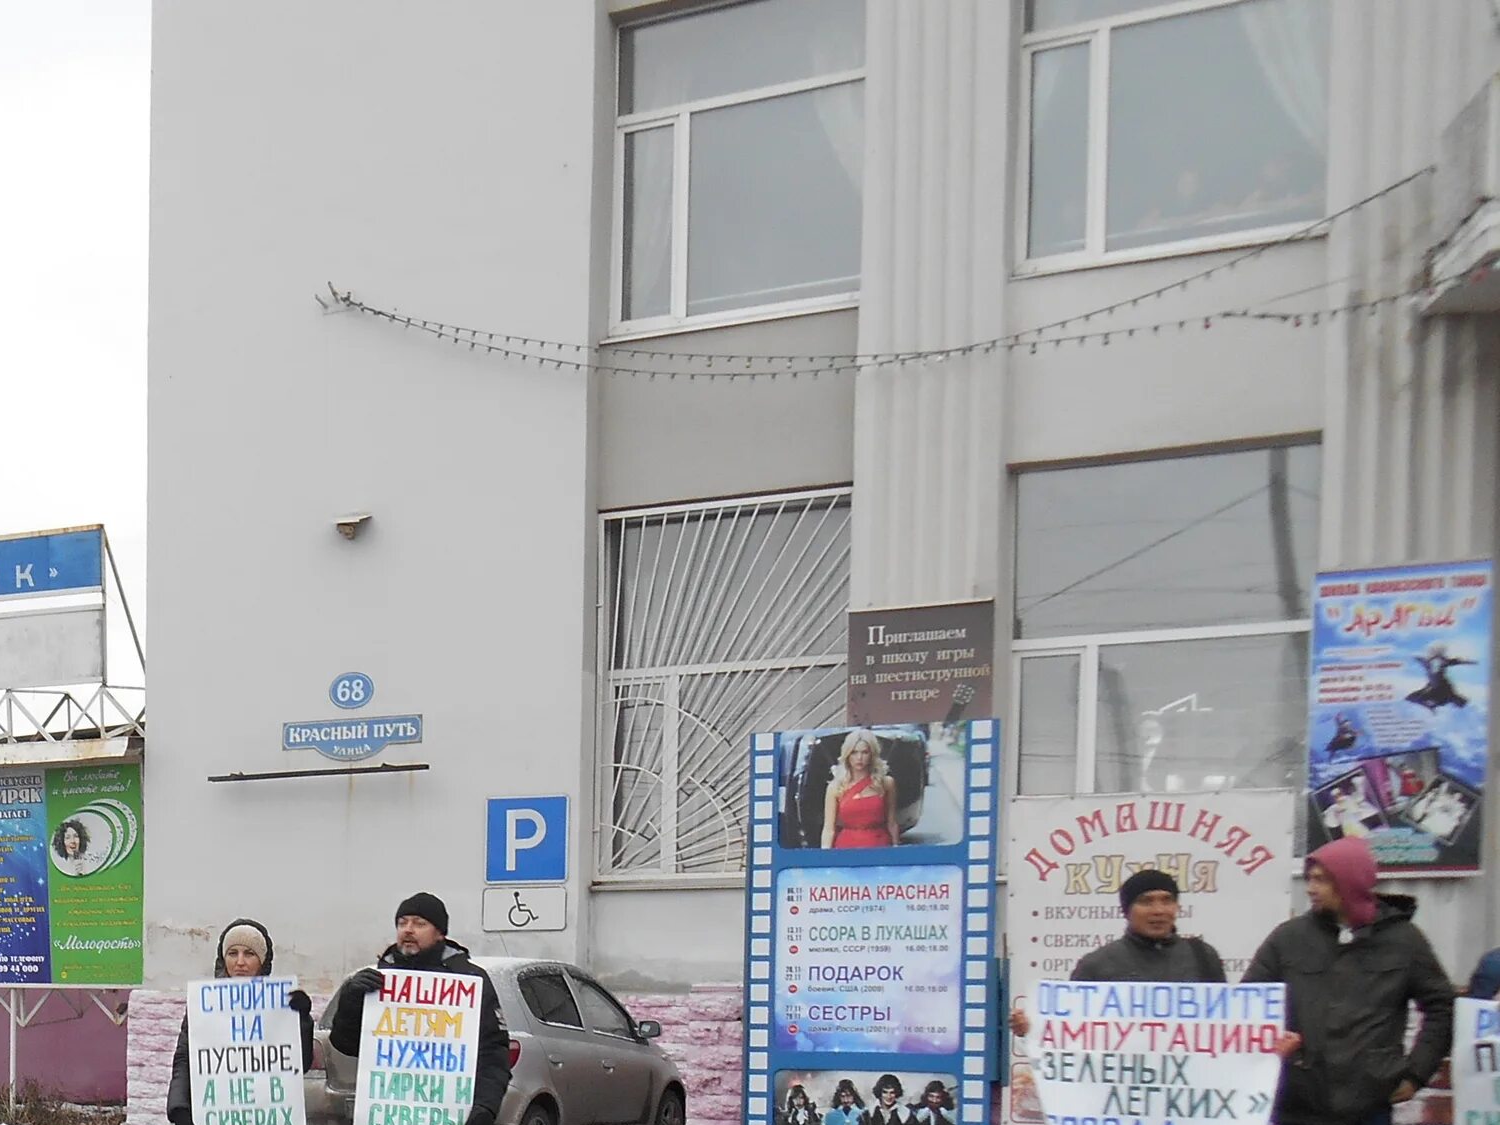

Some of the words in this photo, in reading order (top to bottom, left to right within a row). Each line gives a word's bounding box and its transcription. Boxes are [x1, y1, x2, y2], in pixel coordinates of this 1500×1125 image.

[867, 625, 966, 646] Приглашаем
[866, 655, 875, 665] в
[882, 651, 929, 664] школу
[937, 648, 975, 662] игры
[850, 674, 867, 685] на
[875, 664, 991, 682] шестиструнной
[337, 679, 364, 702] 68
[891, 687, 940, 701] гитаре
[289, 722, 368, 743] КРАСНЫЙ
[373, 722, 417, 738] ПУТЬ
[333, 743, 371, 755] УЛИЦА
[506, 808, 547, 871] P
[1025, 801, 1274, 881] ДОМАШНЯЯ
[809, 886, 872, 902] КАЛИНА
[876, 884, 949, 900] КРАСНАЯ
[809, 926, 857, 941] ССОРА
[861, 926, 871, 941] В
[875, 925, 948, 941] ЛУКАШАХ
[1044, 934, 1115, 948] СВЕЖАЯ
[53, 934, 142, 954] «Молодость»
[843, 945, 866, 953] СССР
[808, 966, 904, 984] ПОДАРОК
[201, 977, 293, 1013] СТРОЙТЕ
[379, 974, 476, 1008] НАШИМ
[839, 985, 859, 993] США
[1038, 983, 1283, 1020] ОСТАНОВИТЕ
[372, 1007, 464, 1039] ДЕТЯМ
[808, 1006, 891, 1021] СЕСТРЫ
[231, 1014, 264, 1041] НА
[1040, 1020, 1280, 1058] АМПУТАЦИЮ
[198, 1044, 299, 1076] ПУСТЫРЕ,
[376, 1038, 466, 1072] НУЖНЫ
[202, 1078, 216, 1107] А
[229, 1078, 255, 1105] НЕ
[270, 1076, 284, 1103] В
[369, 1070, 444, 1104] ПАРКИ
[456, 1077, 472, 1105] И
